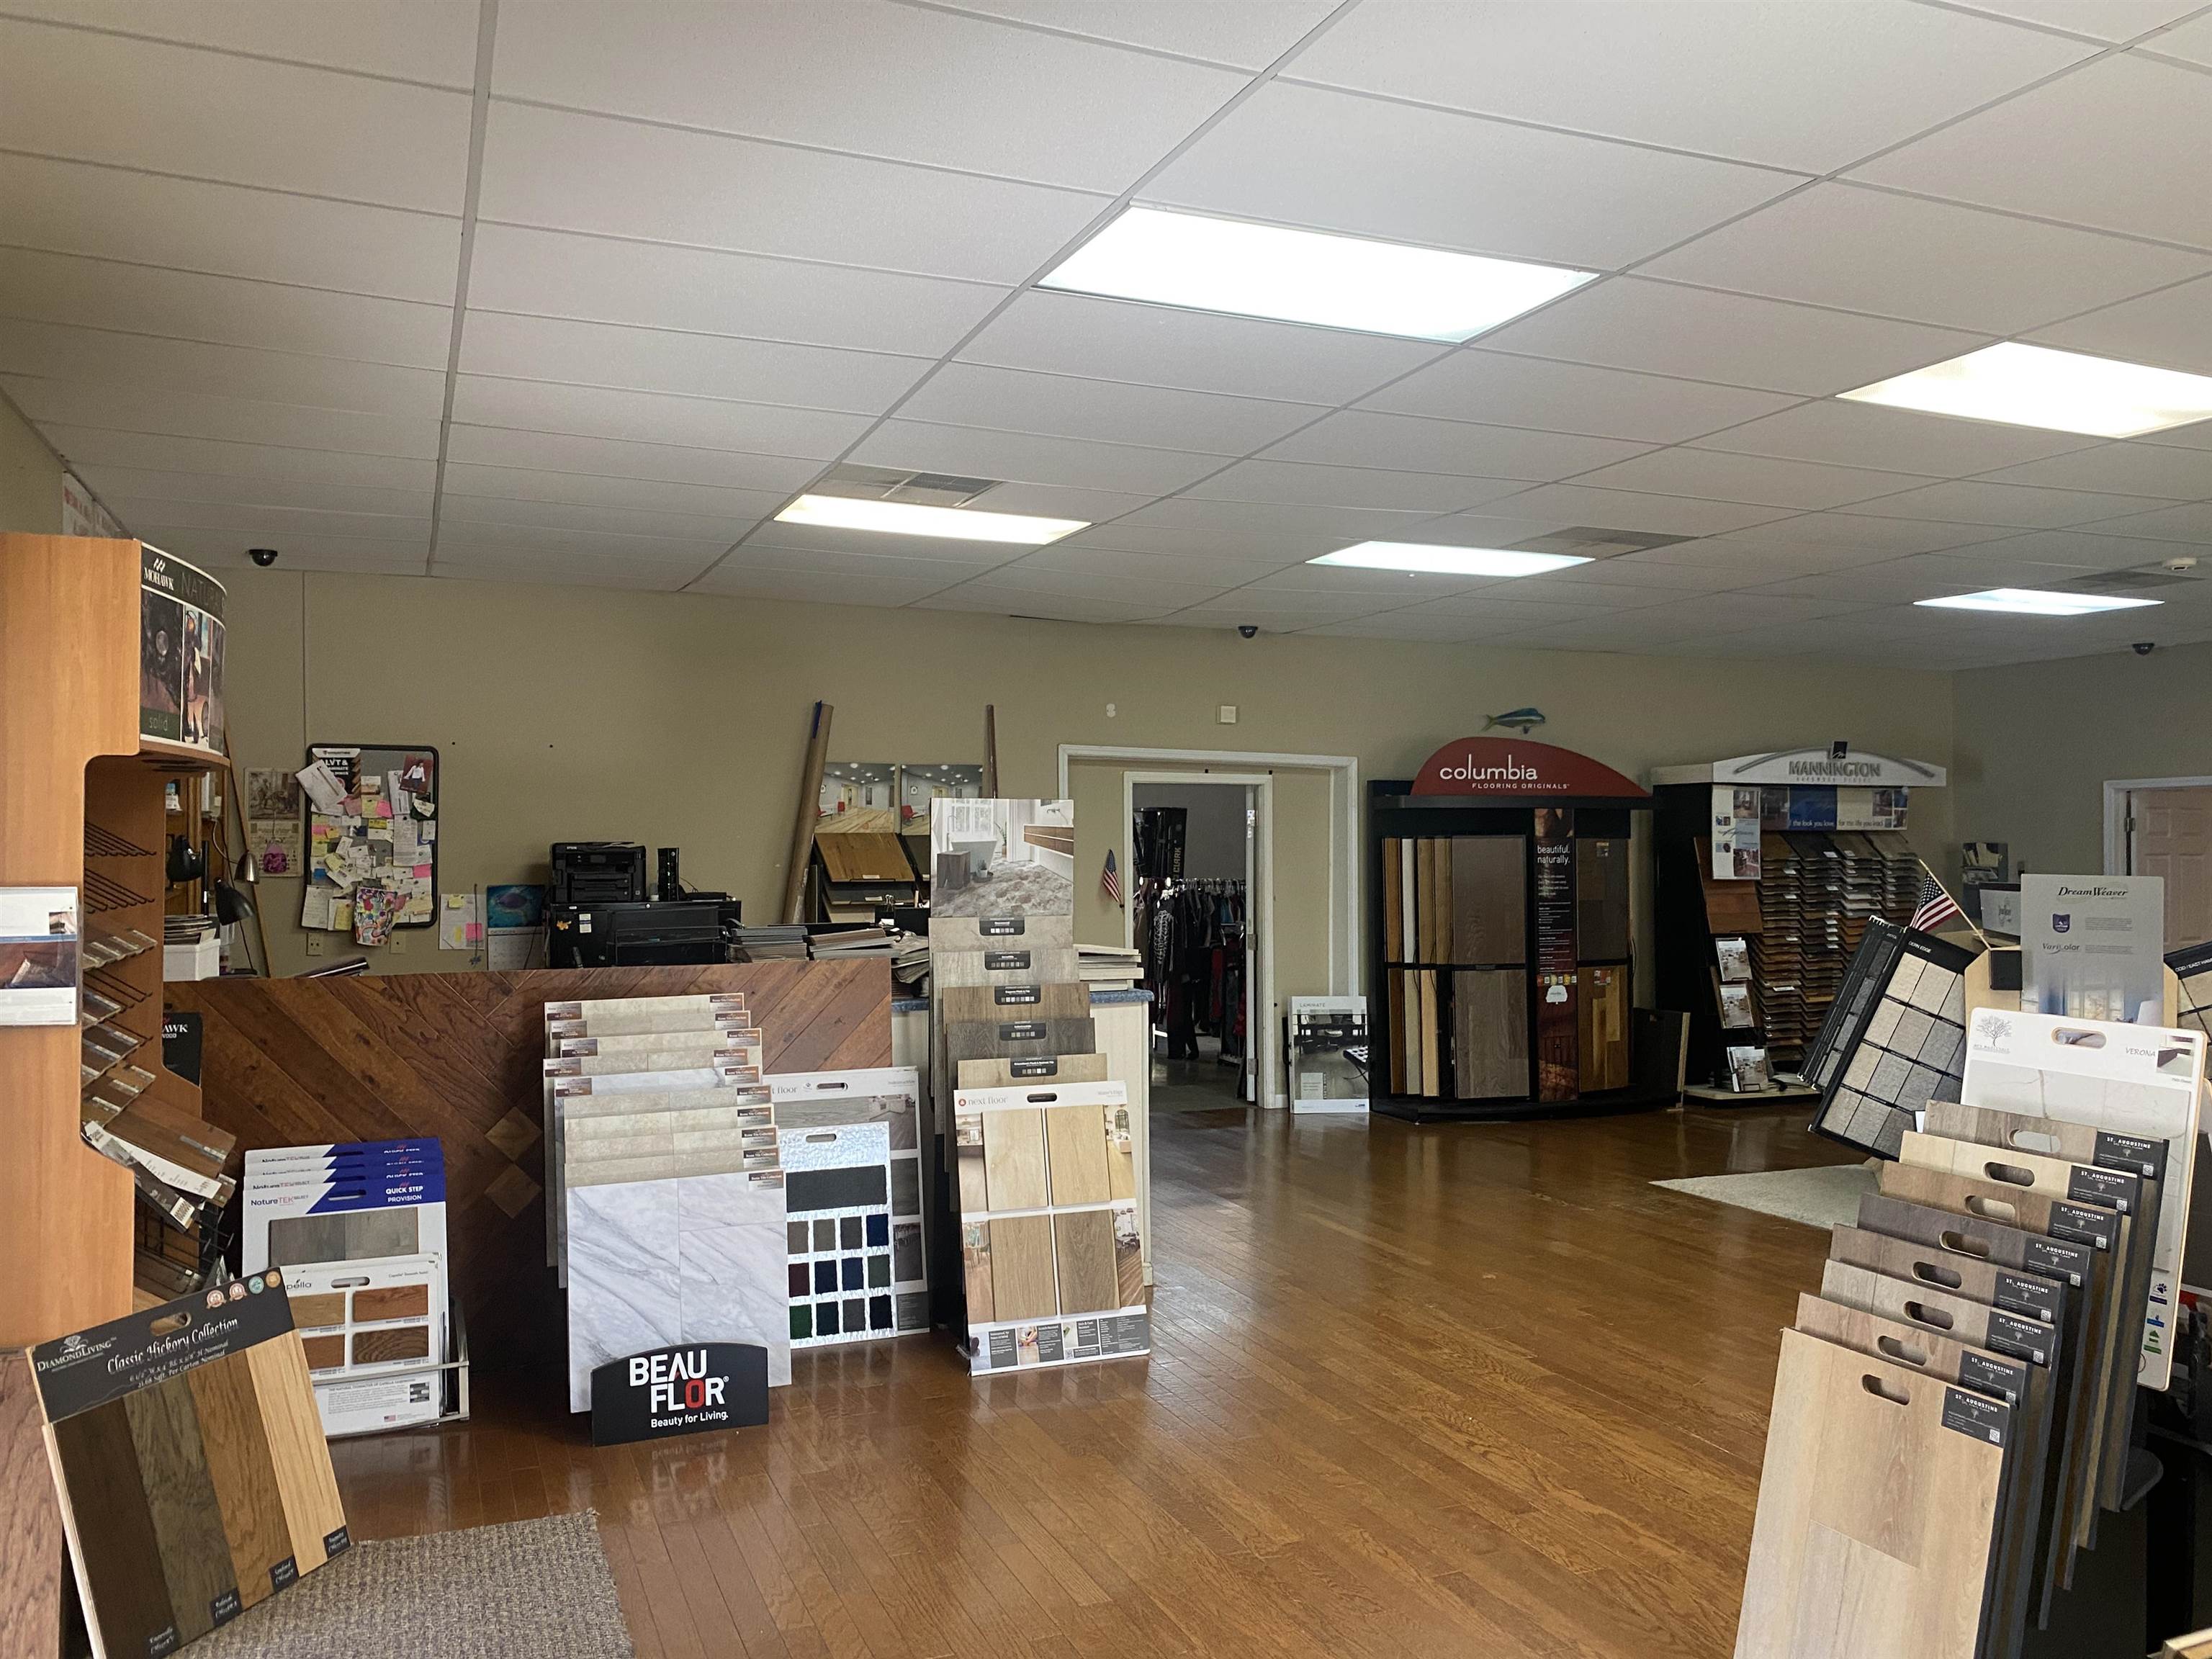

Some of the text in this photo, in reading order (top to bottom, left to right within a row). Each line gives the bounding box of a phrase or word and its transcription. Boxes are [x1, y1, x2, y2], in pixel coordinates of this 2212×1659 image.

[144, 567, 174, 590] MOHAWK
[1439, 753, 1538, 780] columbia
[1789, 761, 1881, 777] MANNINGTON
[1537, 845, 1570, 854] beautiful.
[1173, 847, 1182, 873] CLARK
[1537, 855, 1570, 866] naturally.
[162, 1024, 188, 1033] AWK
[2126, 1048, 2156, 1056] VERONA
[988, 1095, 1007, 1105] floor
[2118, 1139, 2151, 1148] AUGUSTINE
[2092, 1173, 2125, 1184] AUGUSTINE
[2072, 1209, 2104, 1220] AUGUSTINE
[2046, 1246, 2078, 1258] AUGUSTINE
[2017, 1281, 2049, 1293] AUGUSTINE
[2010, 1321, 2042, 1334] AUGUSTINE
[107, 1318, 238, 1375] Classic Hickory Collection
[629, 1349, 707, 1387] BEAU
[1982, 1361, 2013, 1375] AUGUSTINE
[1966, 1398, 1997, 1413] AUGUSTINE
[651, 1411, 729, 1429] Beauty for Living.
